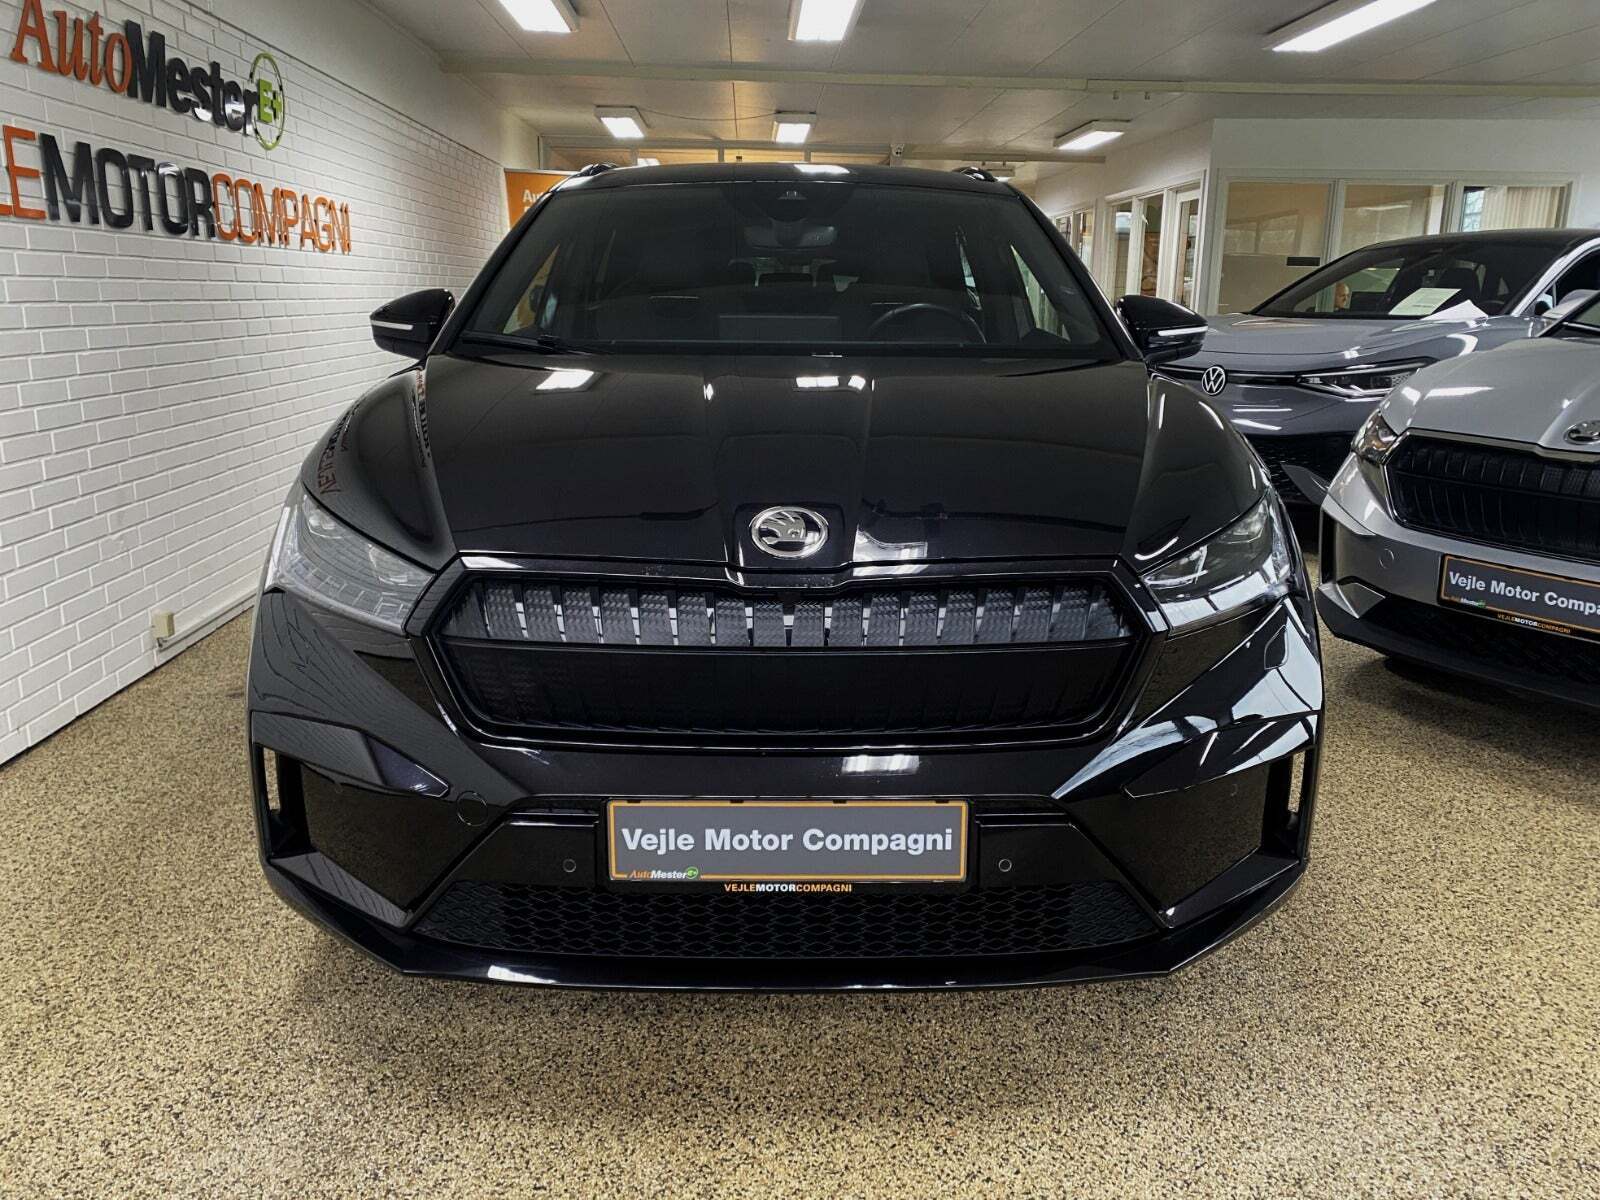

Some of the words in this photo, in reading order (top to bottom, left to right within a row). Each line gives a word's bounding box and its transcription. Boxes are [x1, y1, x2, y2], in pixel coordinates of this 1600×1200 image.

[10, 0, 259, 136] AutoMester
[0, 125, 352, 255] EMOTORCOMPAGNI
[1449, 571, 1486, 591] Vejle
[1490, 580, 1540, 602] Motor
[621, 828, 694, 855] Vejle
[704, 828, 793, 851] Motor
[802, 828, 953, 855] Compagni
[629, 869, 688, 879] AutoMester
[724, 883, 852, 893] VEJLEMOTORCOMPAGNI
